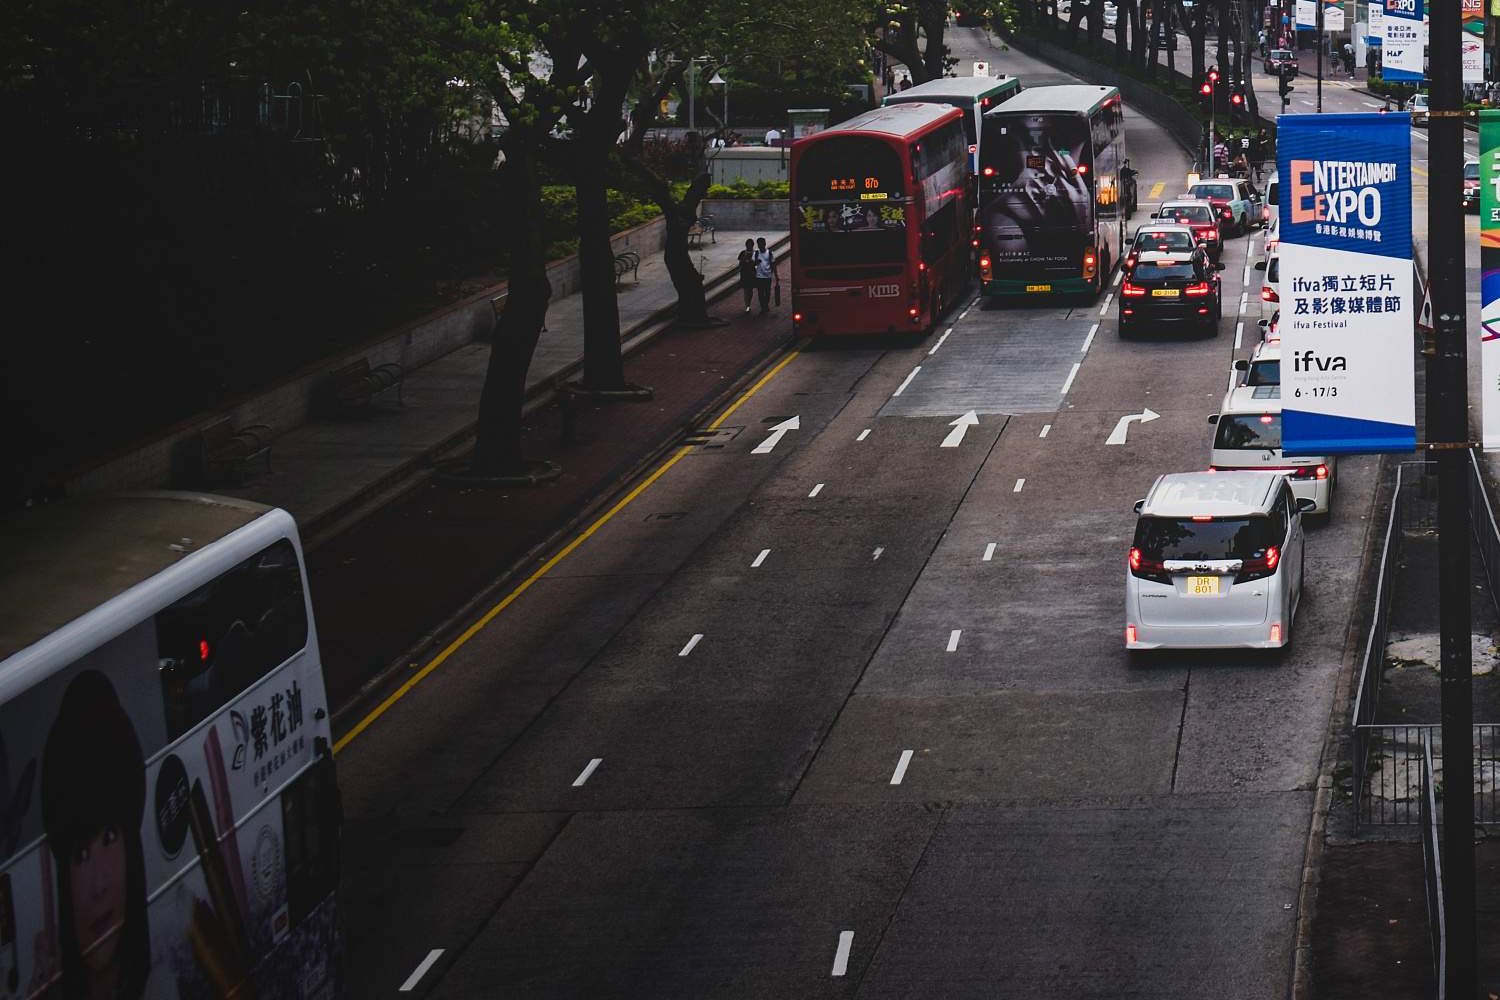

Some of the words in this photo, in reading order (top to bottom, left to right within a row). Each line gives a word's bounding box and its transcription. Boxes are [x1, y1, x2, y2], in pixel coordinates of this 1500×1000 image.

[1462, 0, 1481, 8] NG
[865, 178, 878, 188] 87D
[1291, 160, 1396, 223] ENTERTAINMENT
[1315, 187, 1381, 226] EXPO
[869, 285, 900, 297] KMB
[1293, 274, 1395, 292] ifva獨立短片
[1294, 296, 1401, 315] 及影像媒體節
[1294, 321, 1310, 329] ifva
[1313, 320, 1347, 329] Festival
[1294, 351, 1346, 371] ifva
[1295, 387, 1301, 397] 6
[1313, 387, 1338, 397] 17/3
[250, 681, 303, 760] 紫花油
